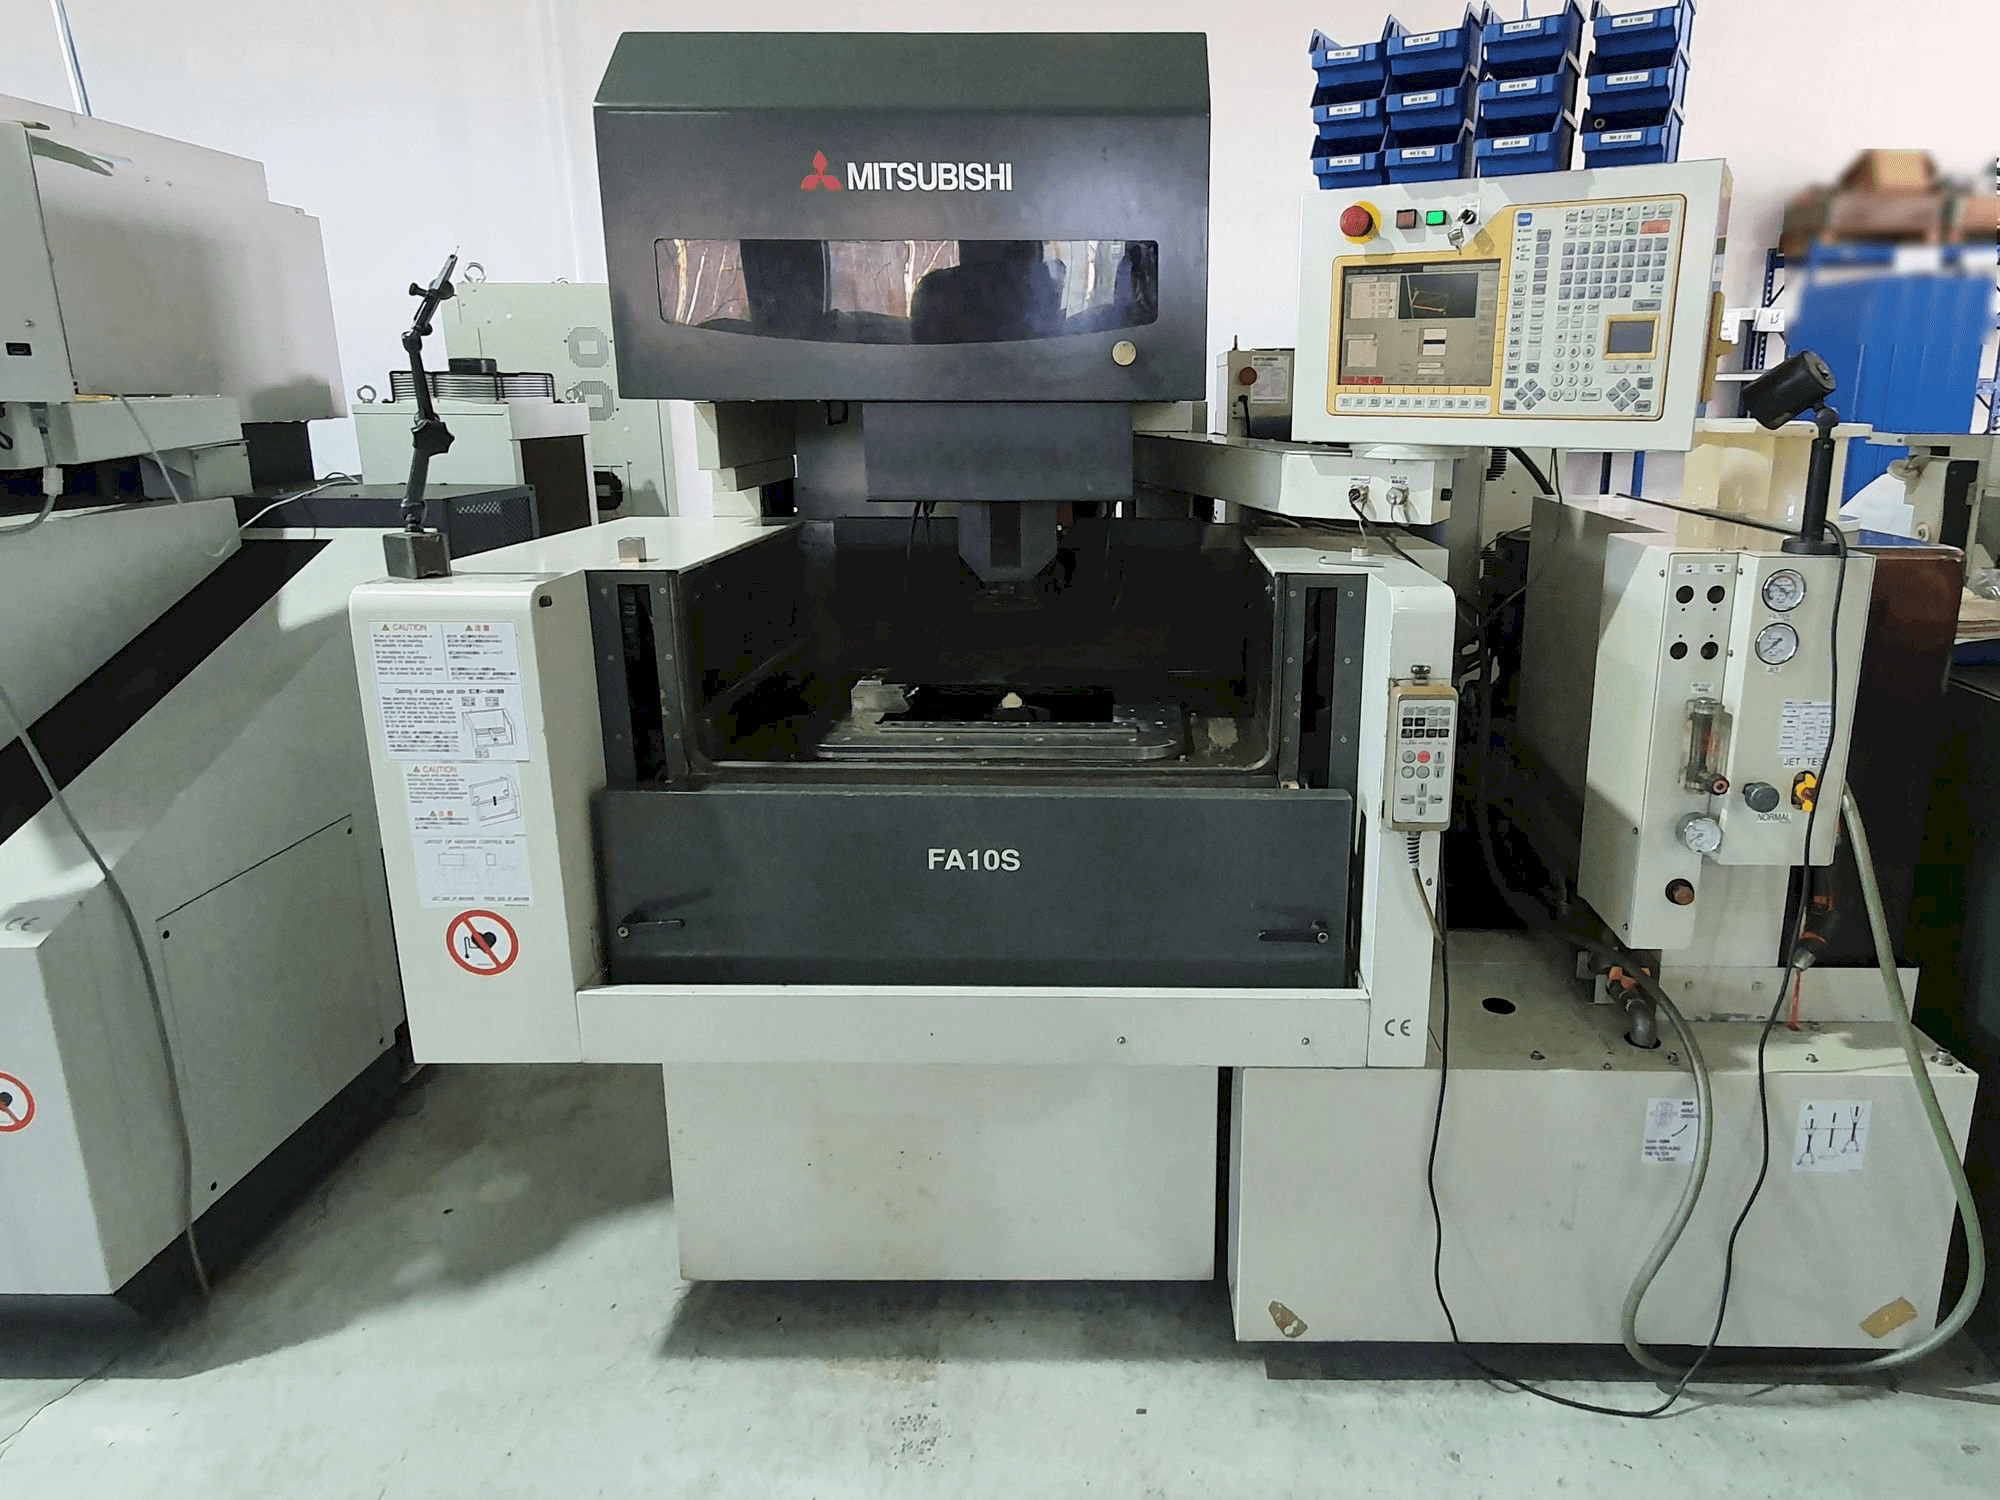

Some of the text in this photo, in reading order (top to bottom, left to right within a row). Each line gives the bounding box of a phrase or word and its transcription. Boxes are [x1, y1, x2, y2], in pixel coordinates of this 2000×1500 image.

[846, 161, 1013, 192] MITSUBISHI
[1783, 757, 1824, 766] JET TES
[1757, 813, 1790, 821] NORMAL
[928, 848, 1021, 871] FA10S
[1384, 1018, 1411, 1037] CE
